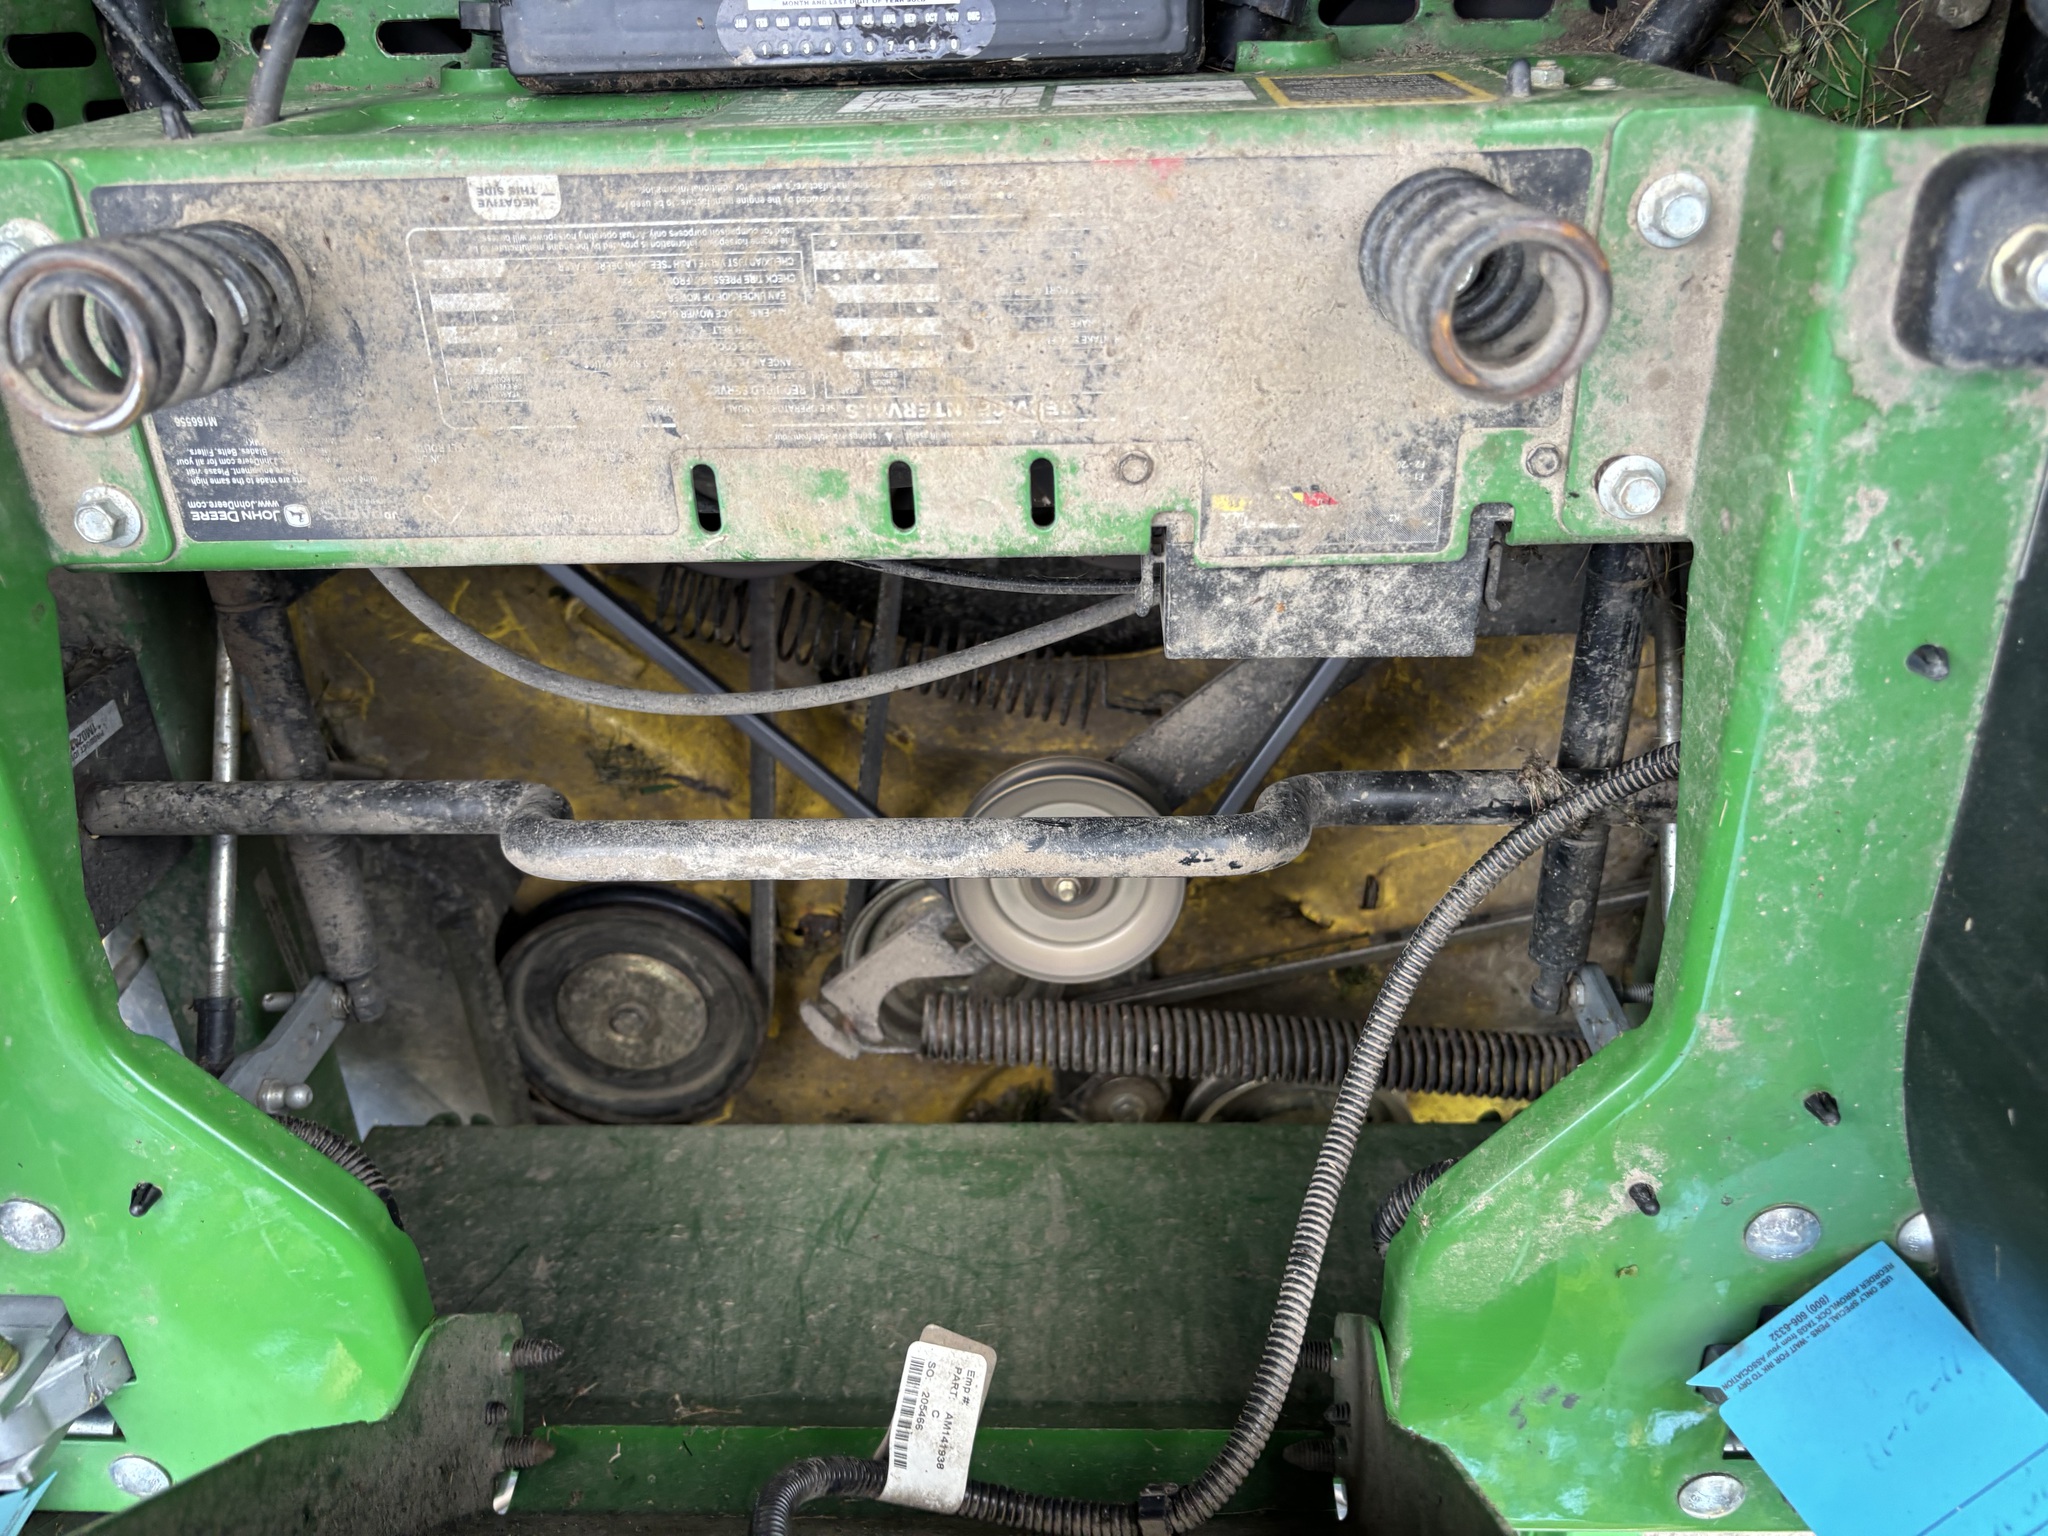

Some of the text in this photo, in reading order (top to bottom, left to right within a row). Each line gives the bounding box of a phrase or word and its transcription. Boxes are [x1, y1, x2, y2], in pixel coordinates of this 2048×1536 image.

[734, 11, 980, 28] JAN FEB MAR APR MAY JUN JUL AUG SEP OCT NOV DEC
[762, 38, 958, 55] 1 2 3 4 5 6 7 8 9 0
[476, 186, 537, 196] THIS SIDE
[736, 183, 748, 191] for
[477, 198, 538, 208] NEGATIVE
[736, 194, 765, 205] engine
[767, 196, 781, 205] the
[620, 230, 645, 240] Atual
[668, 227, 707, 238] purposes
[512, 234, 526, 244] will
[603, 238, 638, 250] provded
[590, 240, 600, 252] by
[650, 240, 697, 250] information
[744, 274, 762, 284] TIRE
[766, 274, 795, 283] CHECK
[702, 292, 714, 301] OF
[718, 291, 765, 300] UNDERDE
[680, 309, 714, 319] MOWER
[845, 401, 966, 420] NTERVS
[173, 416, 218, 427] M166556
[176, 456, 193, 466] your
[206, 458, 218, 466] for
[1415, 460, 1425, 469] F2
[204, 468, 230, 476] Please
[190, 475, 208, 486] high
[232, 476, 244, 485] the
[246, 476, 254, 484] to
[256, 476, 278, 484] made
[188, 500, 280, 510] www.JohnDeere.com
[190, 510, 280, 522] JOHN DEERE
[1876, 1274, 1894, 1290] USE
[1858, 1285, 1878, 1303] ONLY
[1828, 1300, 1860, 1322] SPECIAL
[1768, 1294, 1830, 1341] (800) 606-6332
[1720, 1262, 1895, 1391] REORDER ARROWLOCK TAGS from your ASSOCIATION
[1808, 1320, 1830, 1338] PENS
[1788, 1336, 1808, 1353] WAIT
[1773, 1349, 1790, 1364] FOR
[1761, 1360, 1774, 1373] INK
[1751, 1369, 1762, 1380] TO
[963, 1370, 976, 1394] Emp
[1736, 1376, 1752, 1392] DRY
[915, 1392, 930, 1432] 205466
[932, 1410, 940, 1418] C
